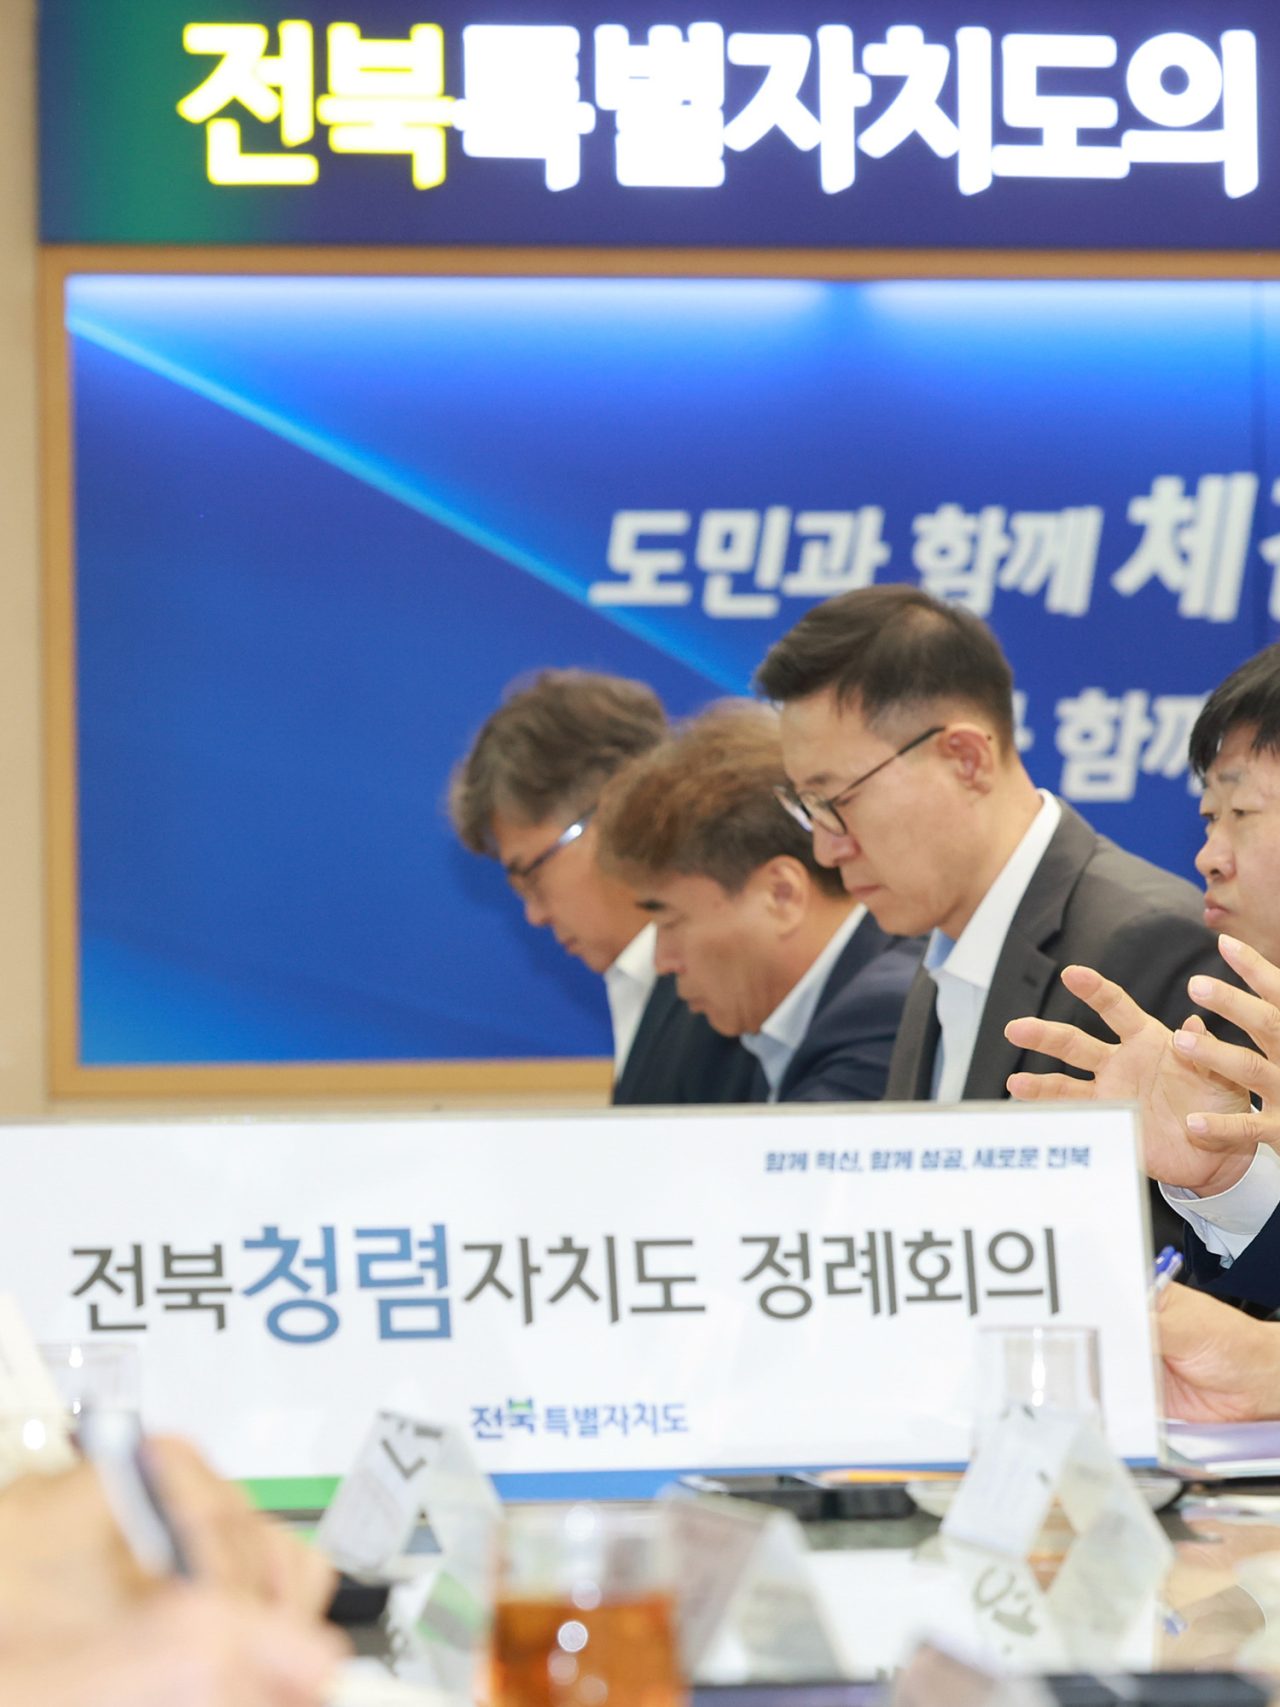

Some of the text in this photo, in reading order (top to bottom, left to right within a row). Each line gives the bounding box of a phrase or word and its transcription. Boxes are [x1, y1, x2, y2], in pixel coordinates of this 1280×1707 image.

[176, 19, 1260, 199] 전북특별자치도의
[588, 504, 892, 618] 도민과
[911, 503, 1104, 618] 함께
[70, 1223, 1062, 1346] 전북청렴자치도 정례회의
